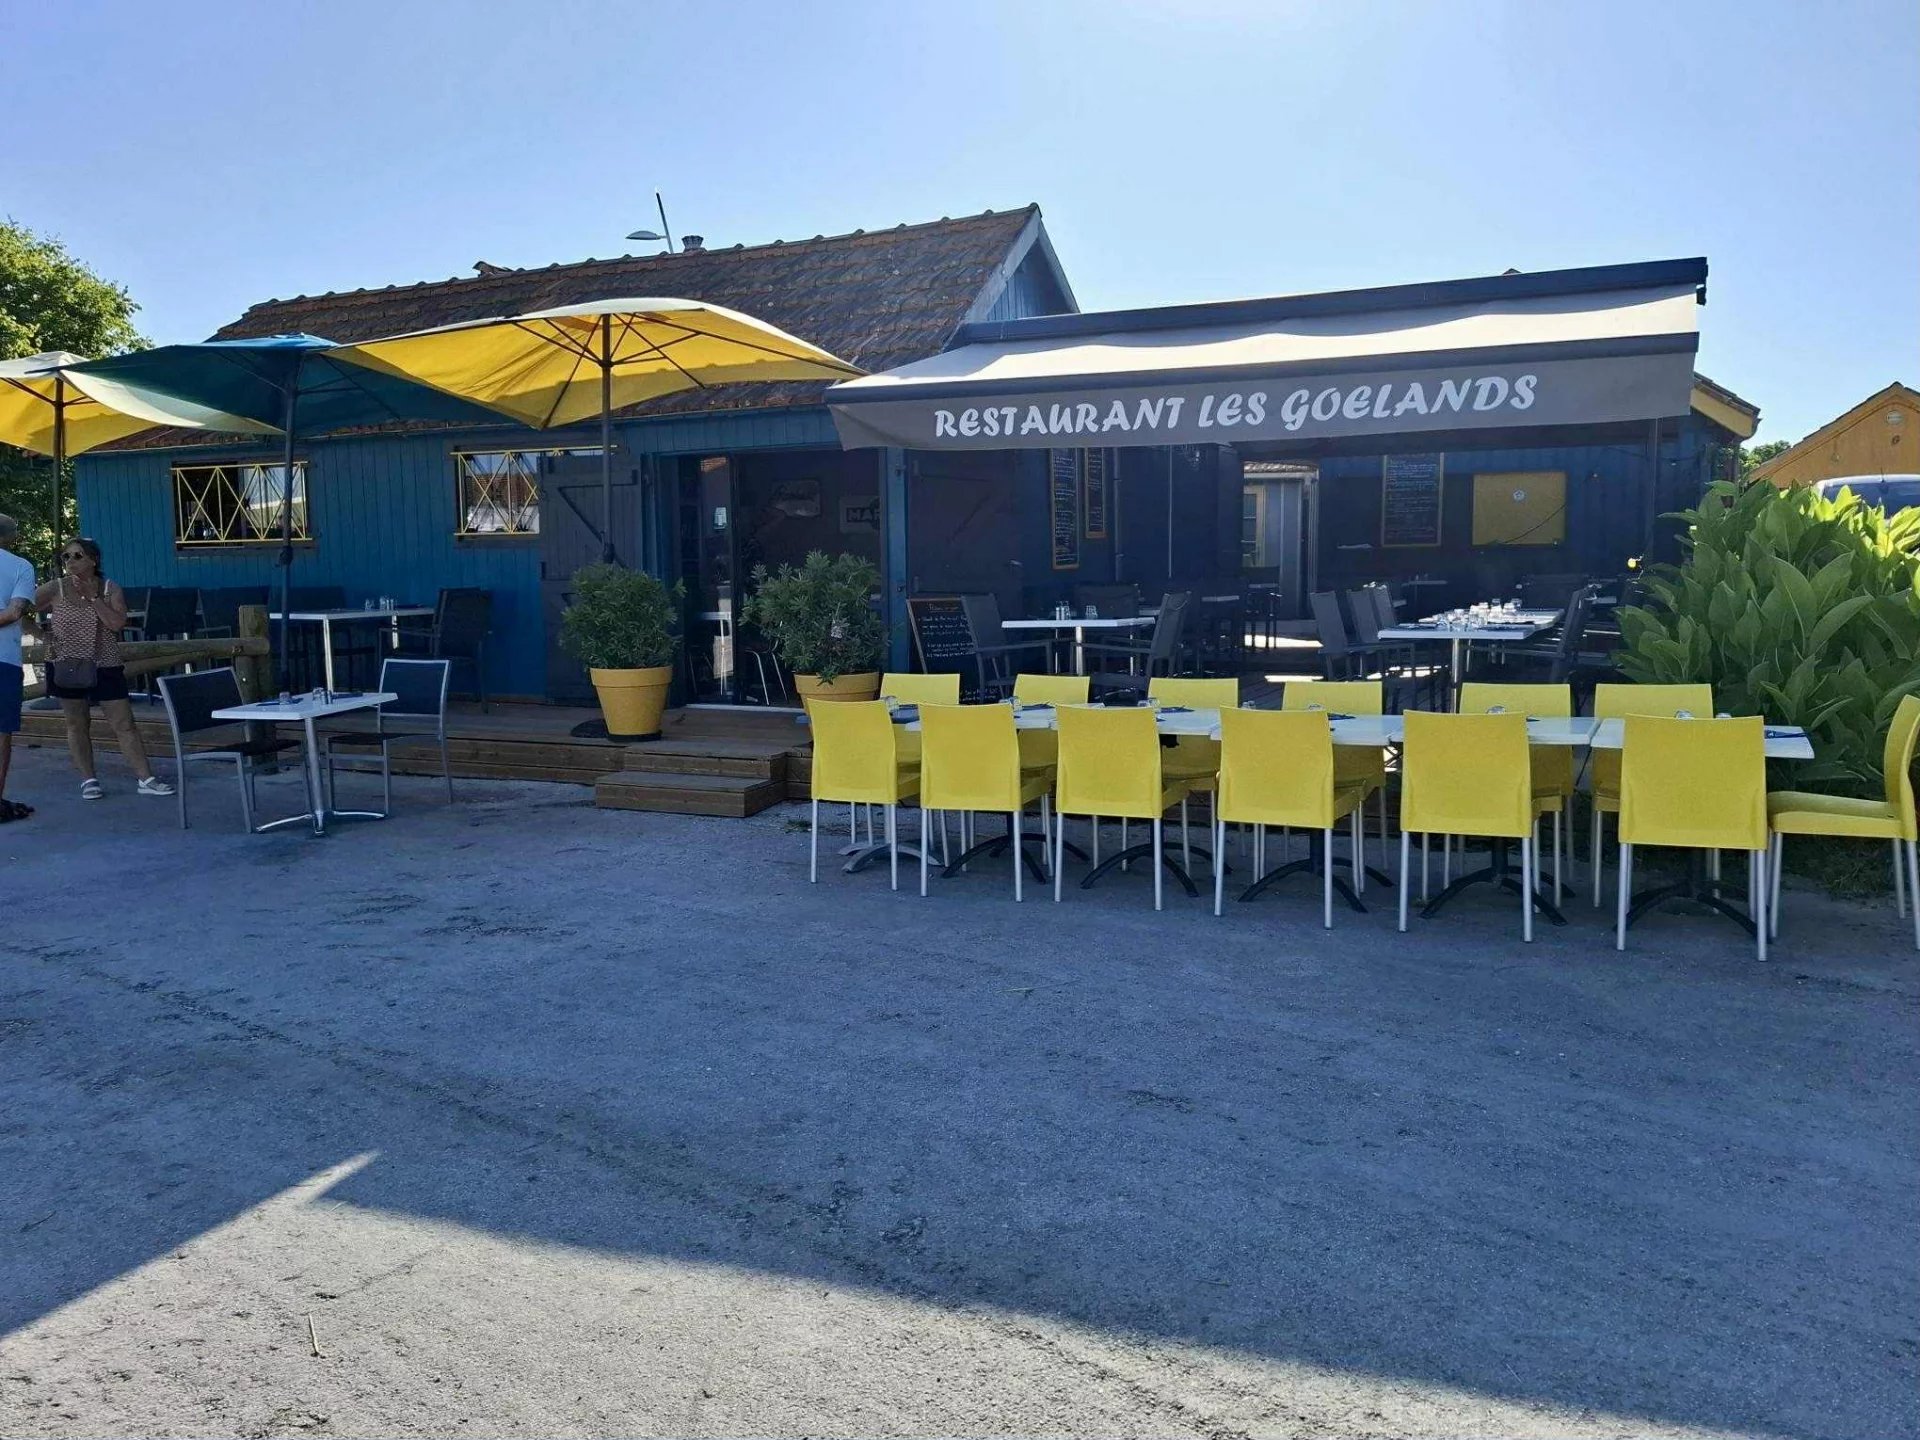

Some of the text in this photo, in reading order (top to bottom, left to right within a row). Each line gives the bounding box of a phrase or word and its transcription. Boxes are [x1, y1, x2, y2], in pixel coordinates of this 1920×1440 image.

[935, 375, 1538, 437] RESTAURANT LES GOELANDS
